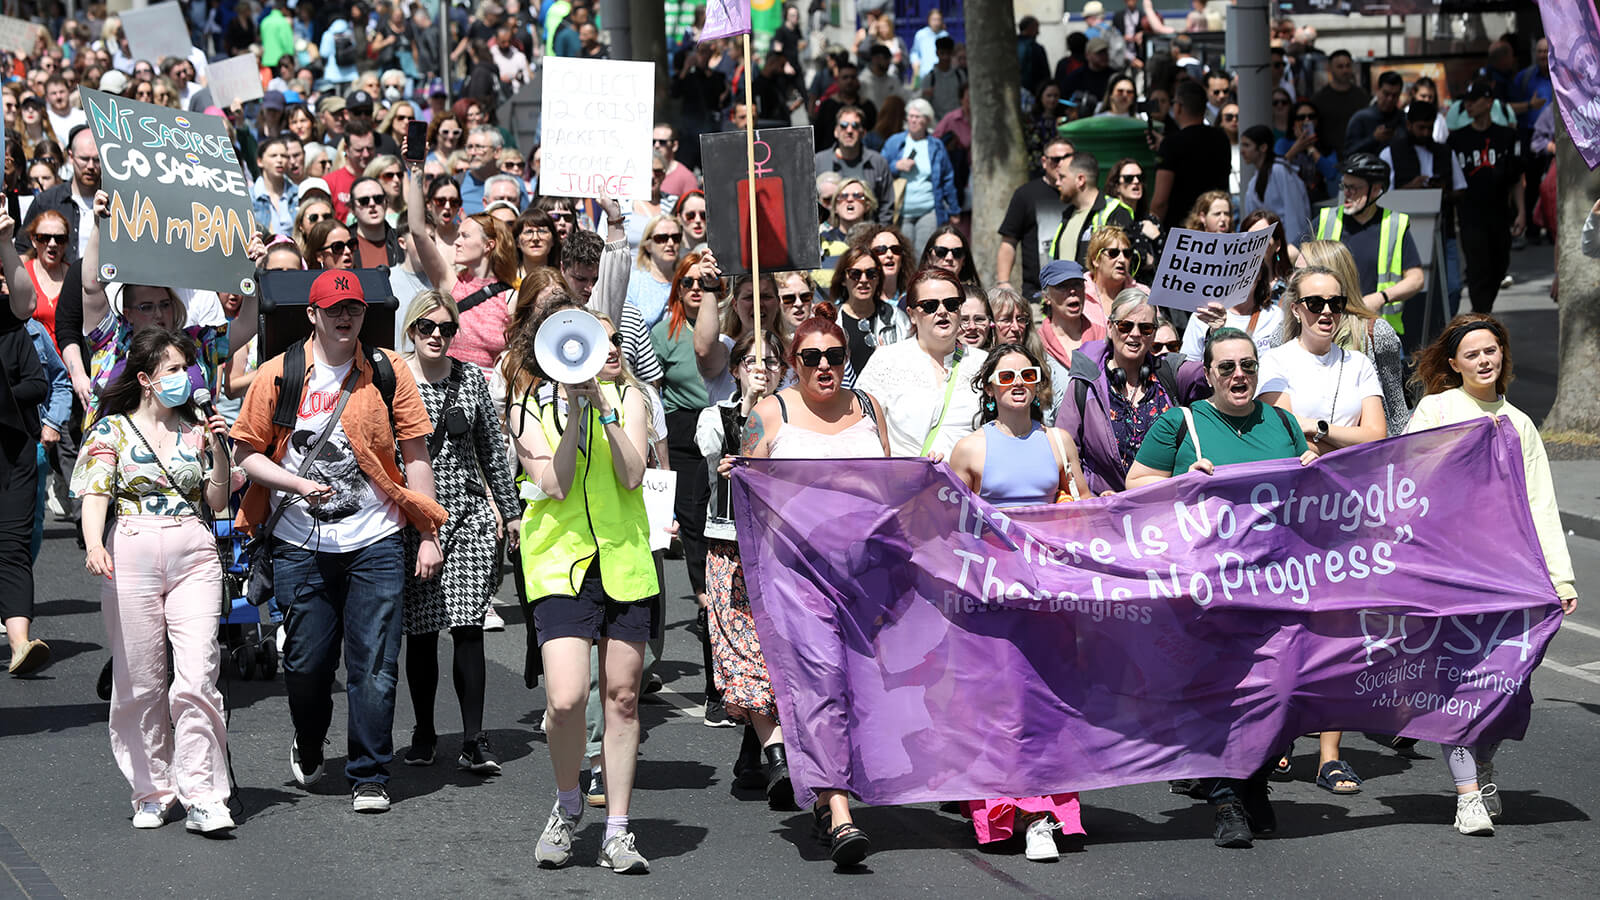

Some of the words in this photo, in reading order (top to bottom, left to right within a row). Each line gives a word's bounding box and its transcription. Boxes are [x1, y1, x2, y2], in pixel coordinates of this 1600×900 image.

[547, 99, 576, 120] 12
[584, 101, 648, 122] CRISP
[139, 116, 239, 164] SAOIRSE
[100, 143, 151, 180] GO
[155, 152, 248, 196] SAOIRSE
[544, 152, 617, 172] BECOME
[624, 157, 637, 176] A
[556, 173, 634, 196] JUDGE
[109, 189, 159, 243] NA
[1176, 234, 1218, 255] End
[1223, 234, 1268, 256] victim
[1161, 274, 1196, 293] the
[1202, 270, 1257, 298] courts!
[1169, 254, 1248, 277] blaming
[1249, 254, 1261, 269] in
[1122, 514, 1169, 559] Is
[1174, 493, 1237, 542] No
[1250, 463, 1430, 532] Struggle,
[1145, 563, 1213, 606] No
[1214, 524, 1414, 605] Progress”
[1357, 609, 1532, 666] ROSA
[1354, 658, 1426, 695] Socialist
[1435, 656, 1523, 695] Feminist
